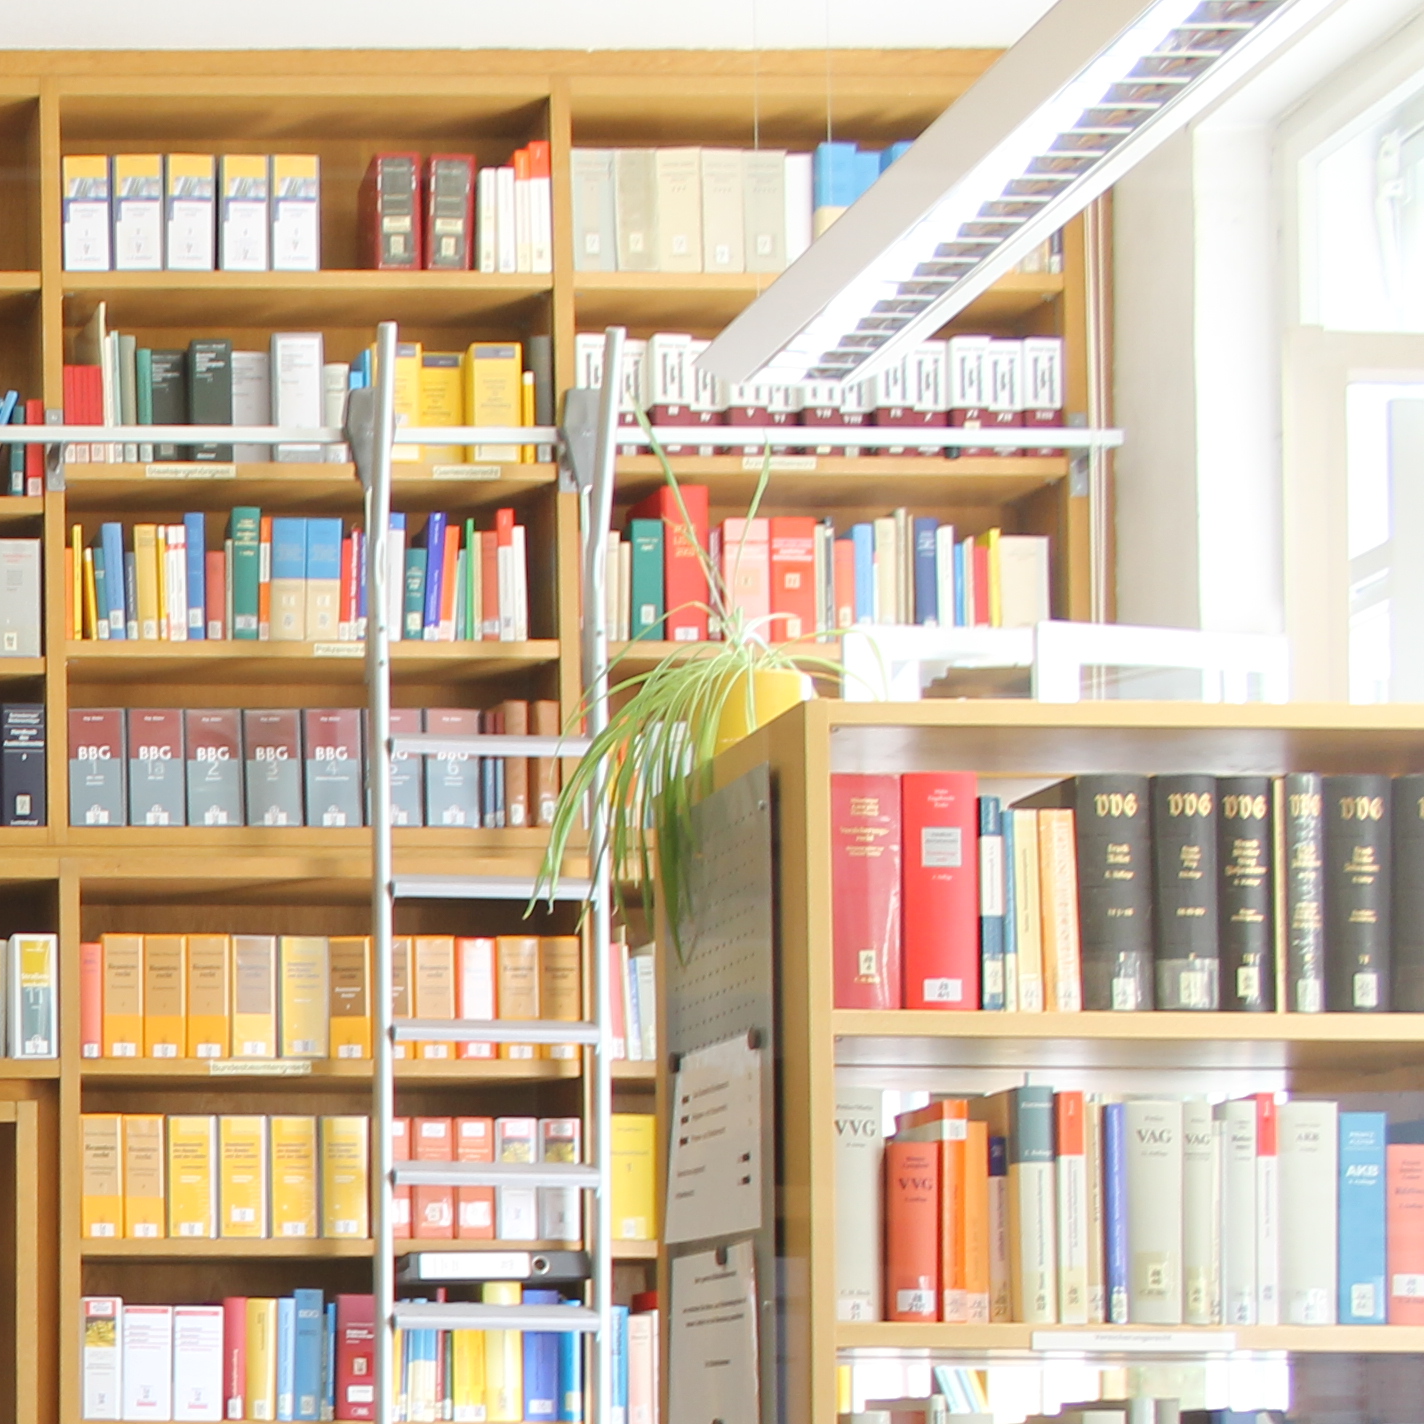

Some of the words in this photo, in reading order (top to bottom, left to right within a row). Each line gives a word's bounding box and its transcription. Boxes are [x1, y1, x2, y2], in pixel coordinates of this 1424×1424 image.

[78, 745, 111, 760] BBG
[138, 745, 171, 760] BBG
[196, 746, 229, 761] BBG
[255, 745, 288, 761] BBG
[315, 746, 347, 761] BBG
[25, 987, 44, 1004] 11
[834, 1120, 877, 1138] VVG
[1136, 1128, 1172, 1144] VAG
[1184, 1133, 1211, 1145] VAG
[1346, 1165, 1379, 1177] AKB
[899, 1178, 933, 1191] VVG
